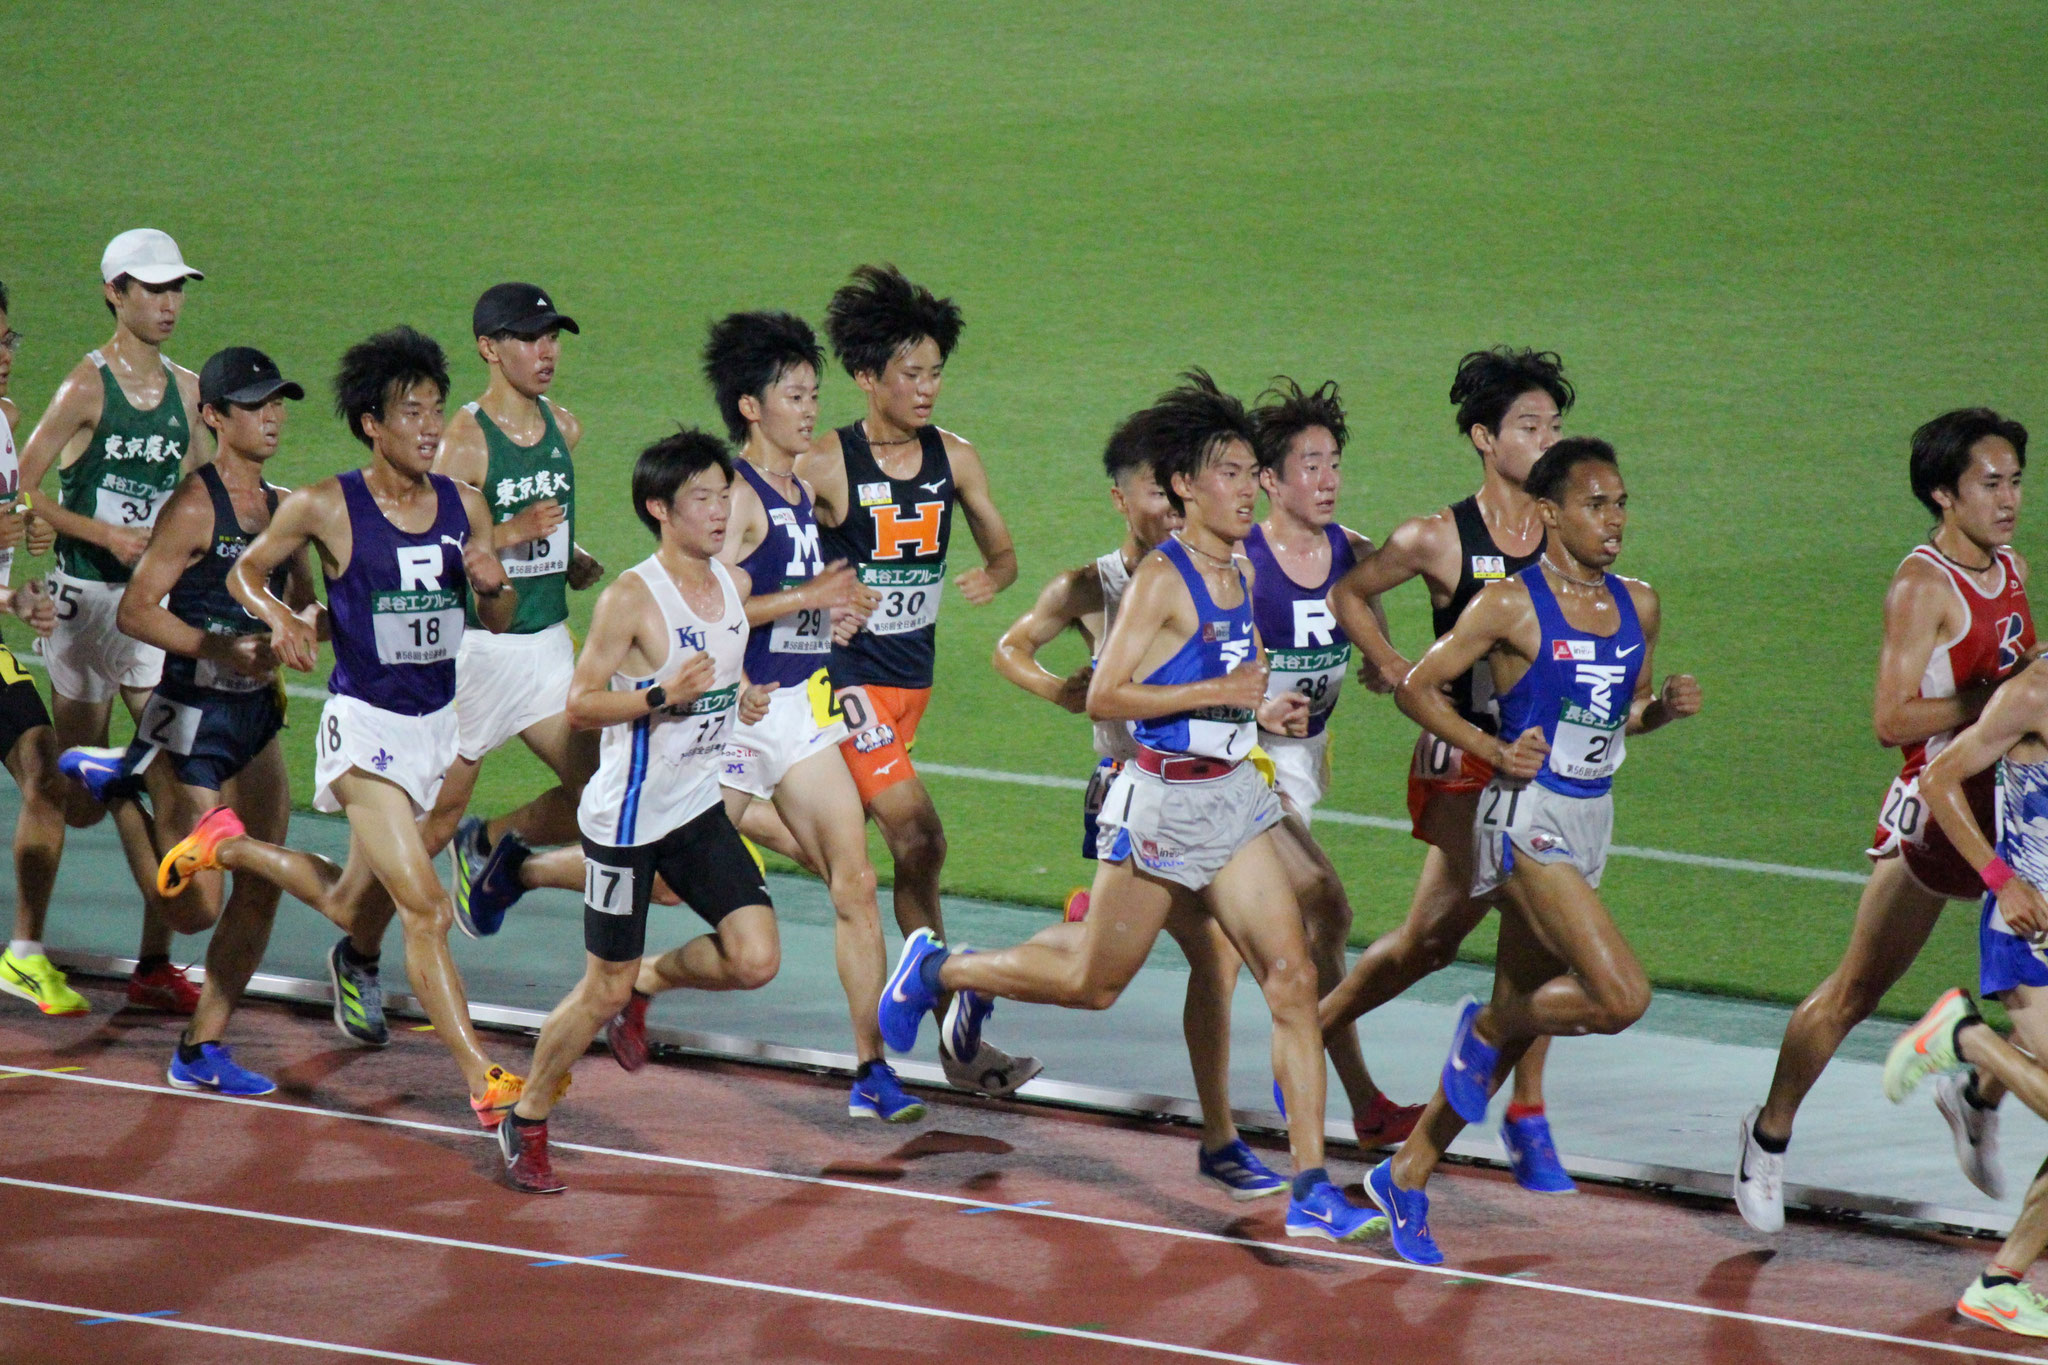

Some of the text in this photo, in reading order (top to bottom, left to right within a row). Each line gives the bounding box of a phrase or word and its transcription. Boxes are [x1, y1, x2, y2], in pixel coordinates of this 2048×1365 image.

[103, 434, 182, 463] 東京農大
[495, 470, 570, 507] 東京農大
[870, 501, 945, 560] H
[396, 544, 444, 592] R
[786, 524, 825, 576] M
[796, 608, 822, 636] 29
[885, 591, 926, 618] 30
[408, 617, 441, 646] 18
[675, 625, 706, 652] KU
[1292, 599, 1337, 648] R
[1296, 674, 1329, 701] 38
[697, 716, 726, 743] 17
[840, 693, 867, 733] 0
[321, 715, 342, 759] 18
[1226, 728, 1238, 755] 1
[725, 763, 745, 774] M
[1483, 785, 1520, 828] 21
[1884, 786, 1921, 835] 20
[590, 865, 621, 908] 17
